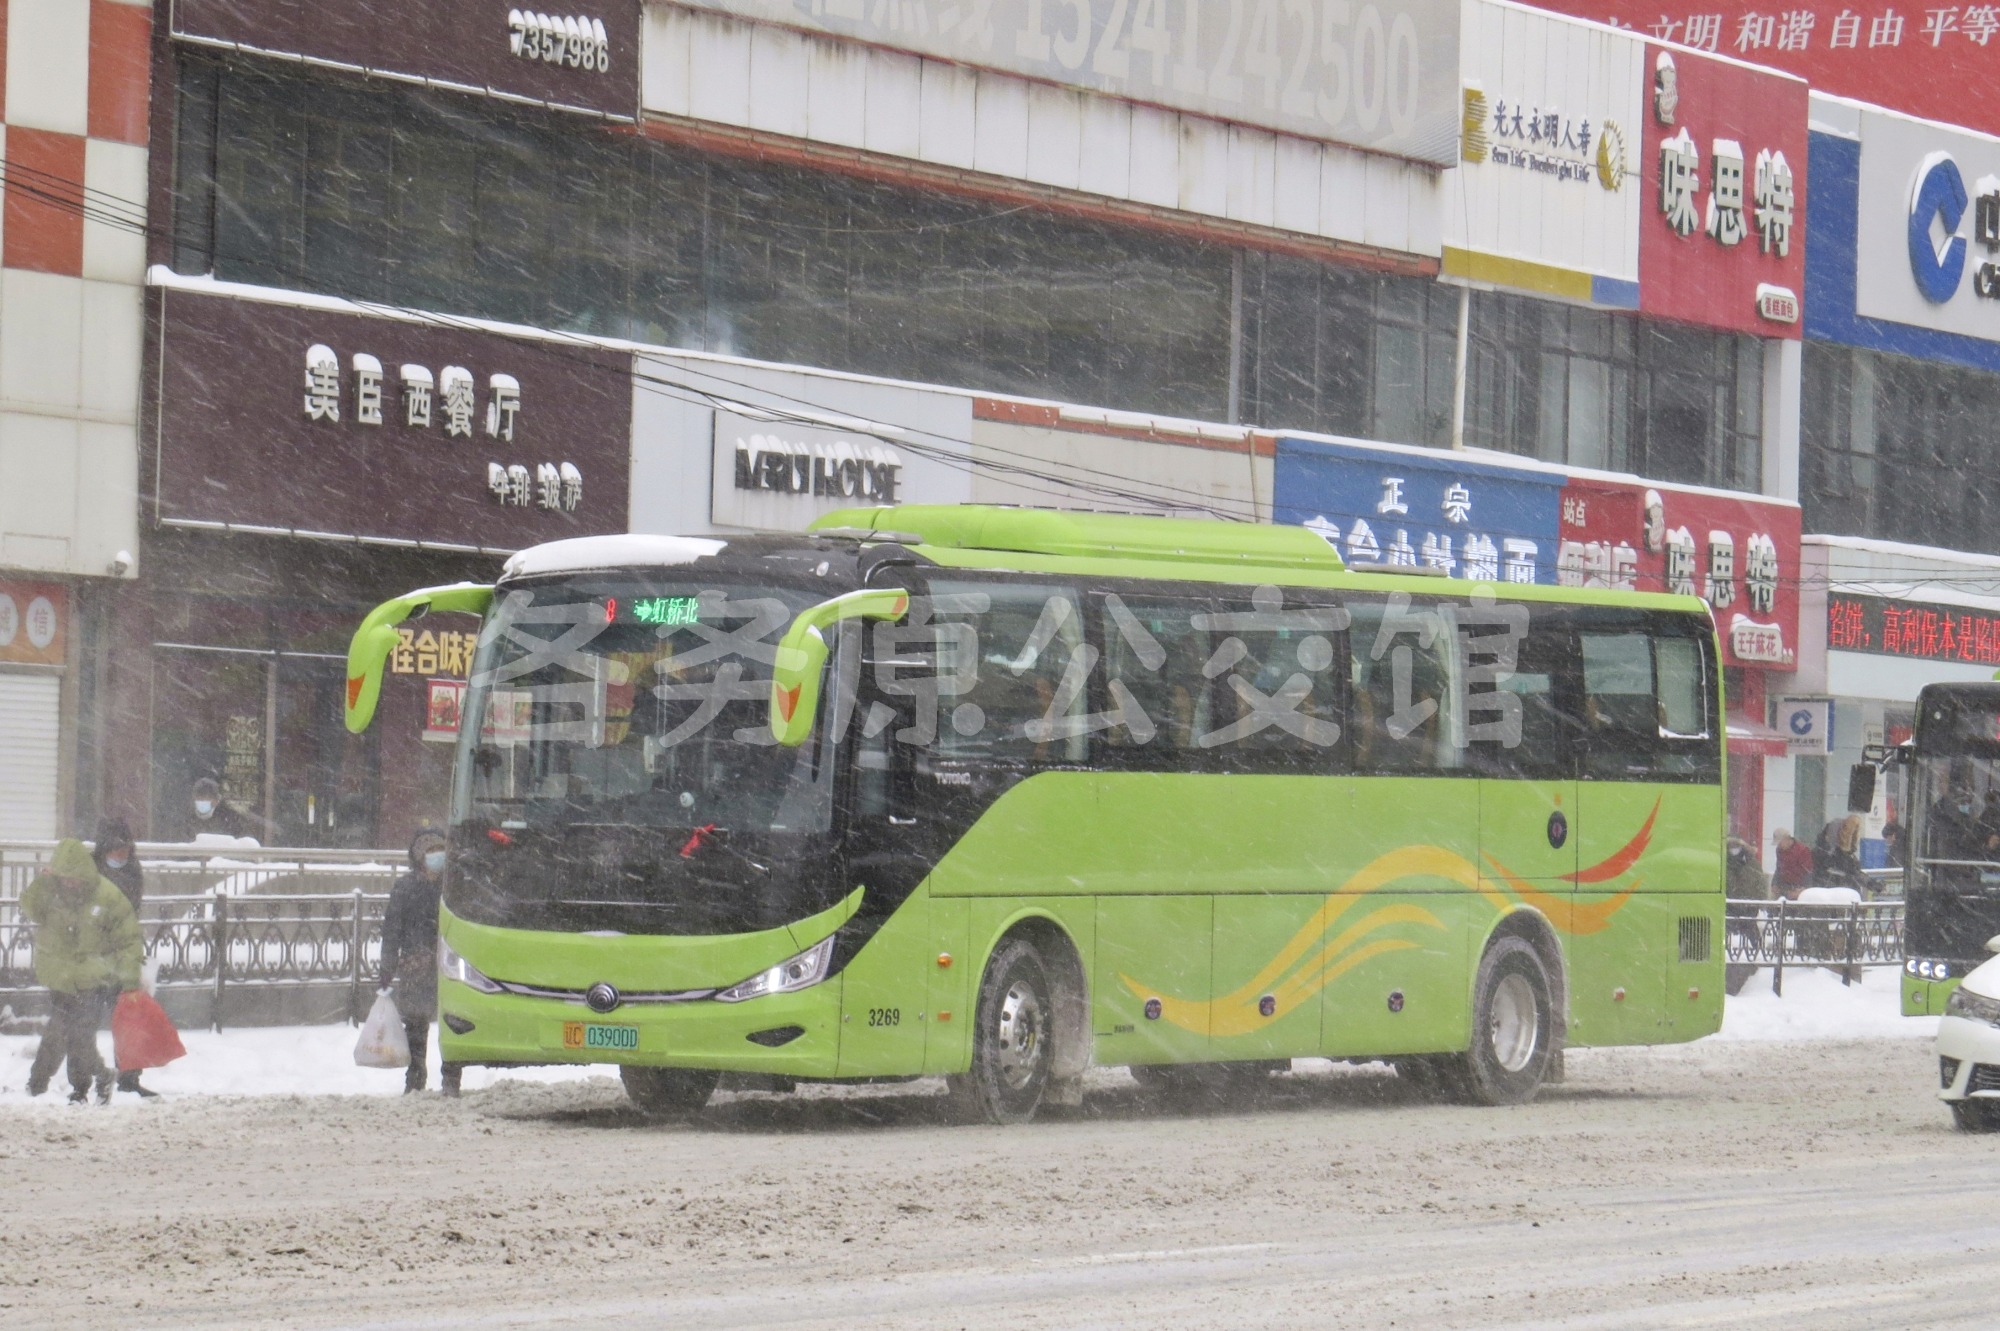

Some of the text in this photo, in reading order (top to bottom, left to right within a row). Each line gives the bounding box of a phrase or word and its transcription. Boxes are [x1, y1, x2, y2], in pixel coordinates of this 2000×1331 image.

[511, 20, 609, 74] 7357986
[1647, 4, 2000, 53] 文明 和谐 自由 平等
[1493, 99, 1592, 157] 光大永明人寿
[1510, 149, 1526, 168] Life
[1573, 163, 1590, 183] Life
[1660, 140, 1795, 258] 味思特
[306, 358, 521, 442] 美臣西餐厅
[493, 470, 531, 508] 牛排
[1379, 477, 1473, 523] 正宗
[1564, 498, 1587, 527] 站点
[1667, 536, 1778, 613] 味思特
[1738, 631, 1777, 657] 王子麻花
[868, 1008, 900, 1027] 3269
